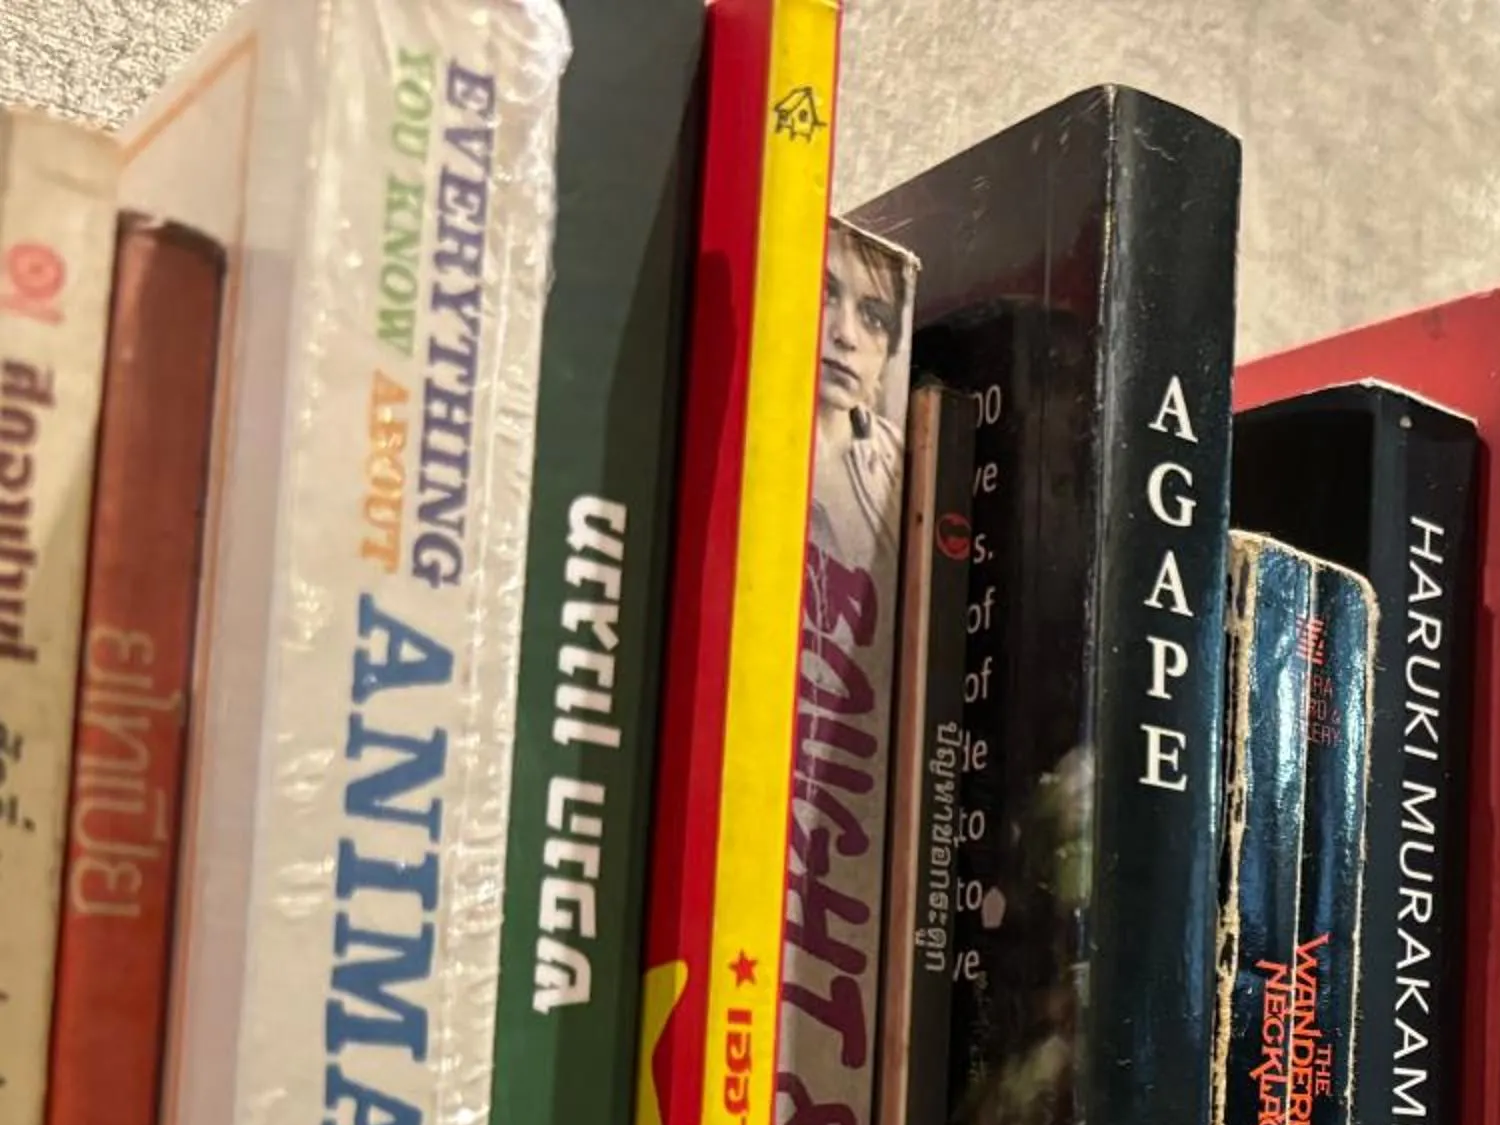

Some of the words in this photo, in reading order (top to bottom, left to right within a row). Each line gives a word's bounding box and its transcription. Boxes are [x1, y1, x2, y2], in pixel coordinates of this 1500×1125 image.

[390, 46, 437, 163] YOU
[376, 172, 426, 357] KNOW
[412, 60, 494, 589] EVERYTHING
[361, 371, 410, 575] ABOUT
[1138, 376, 1198, 792] AGAPE
[551, 494, 628, 750] מנגנון
[1404, 516, 1444, 760] HARUKI
[532, 775, 607, 1015] הנפש
[779, 545, 878, 1069] BOUGHT
[1315, 1045, 1332, 1096] THE
